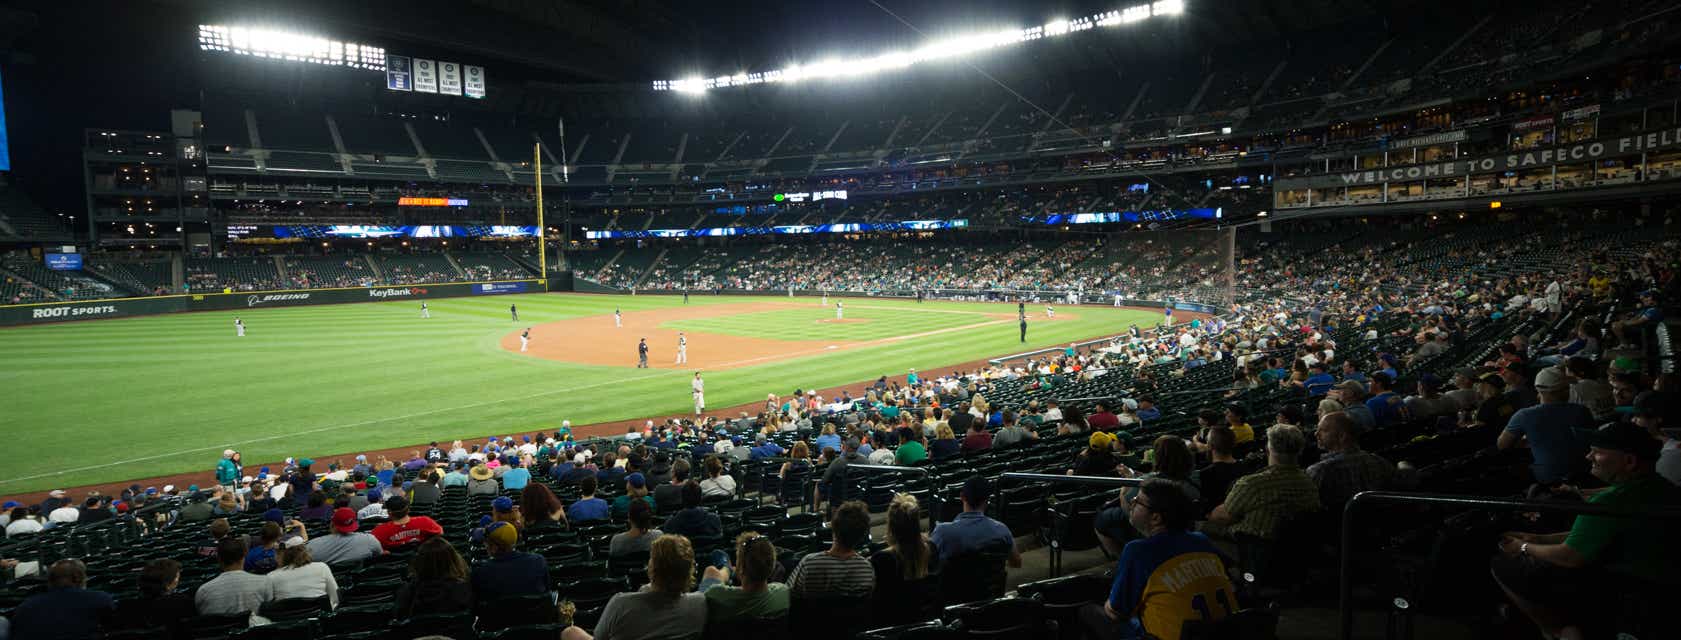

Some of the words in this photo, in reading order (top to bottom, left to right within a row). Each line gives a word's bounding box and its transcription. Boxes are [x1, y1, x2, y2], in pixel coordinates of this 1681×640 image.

[1341, 162, 1455, 184] WELCOME
[1468, 158, 1495, 172] TO
[1506, 142, 1605, 168] SAFECO
[263, 293, 310, 301] BOEING
[369, 287, 412, 298] KeyBank
[32, 306, 71, 319] ROOT
[72, 305, 115, 316] SPORTS
